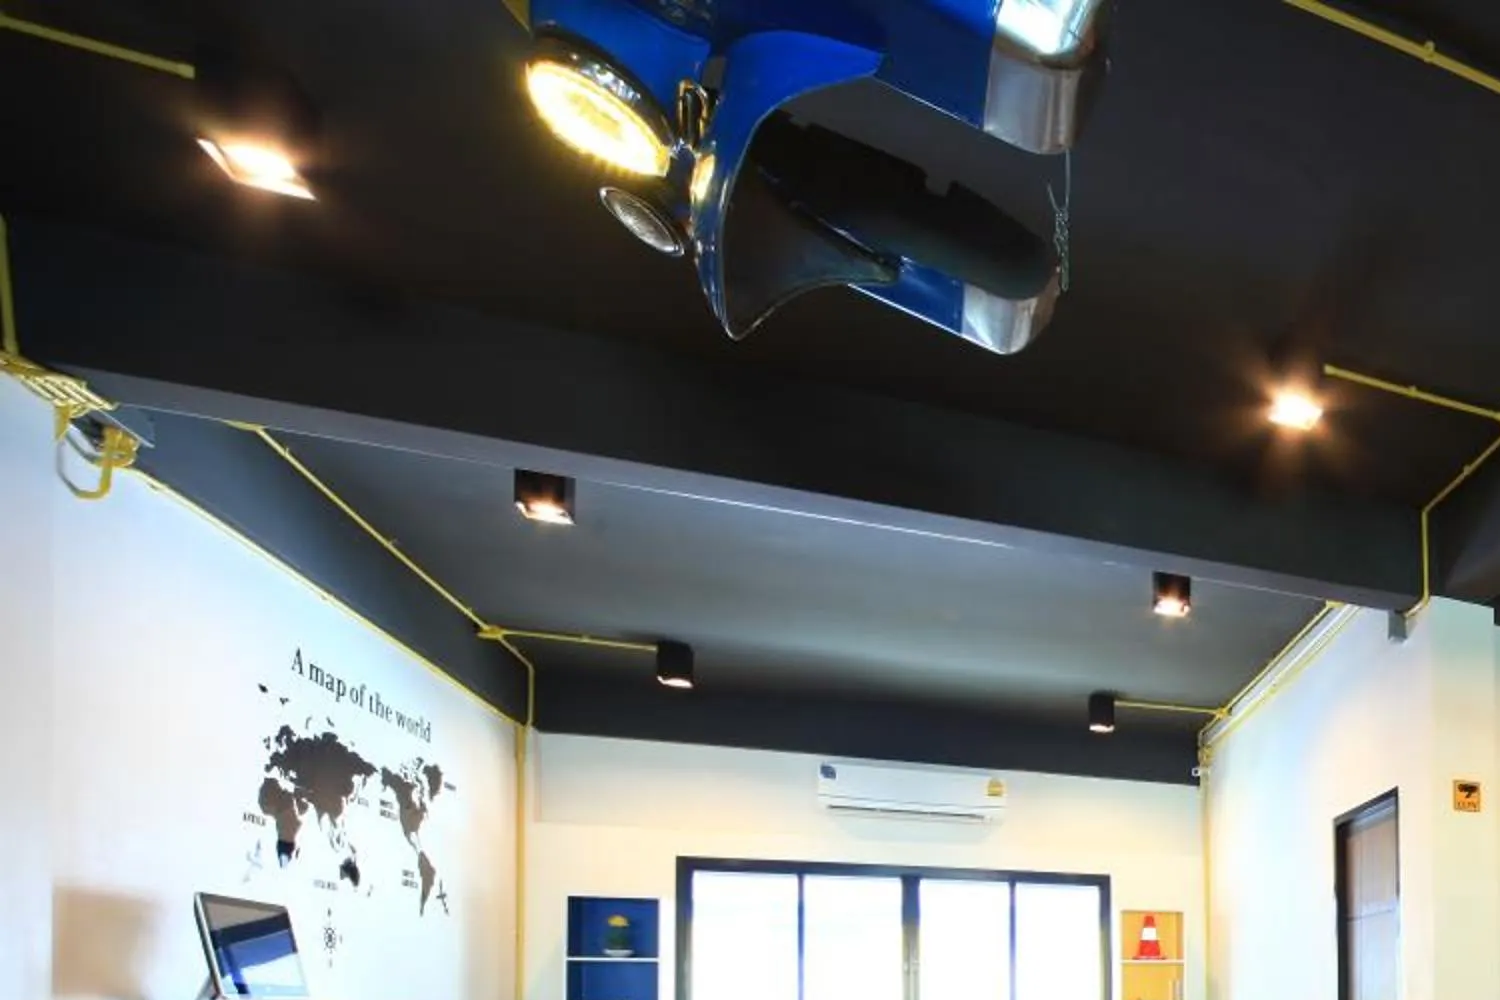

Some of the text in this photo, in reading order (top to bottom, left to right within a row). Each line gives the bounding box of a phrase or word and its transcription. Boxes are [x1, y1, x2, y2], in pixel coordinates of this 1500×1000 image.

[292, 647, 432, 744] A map of the world
